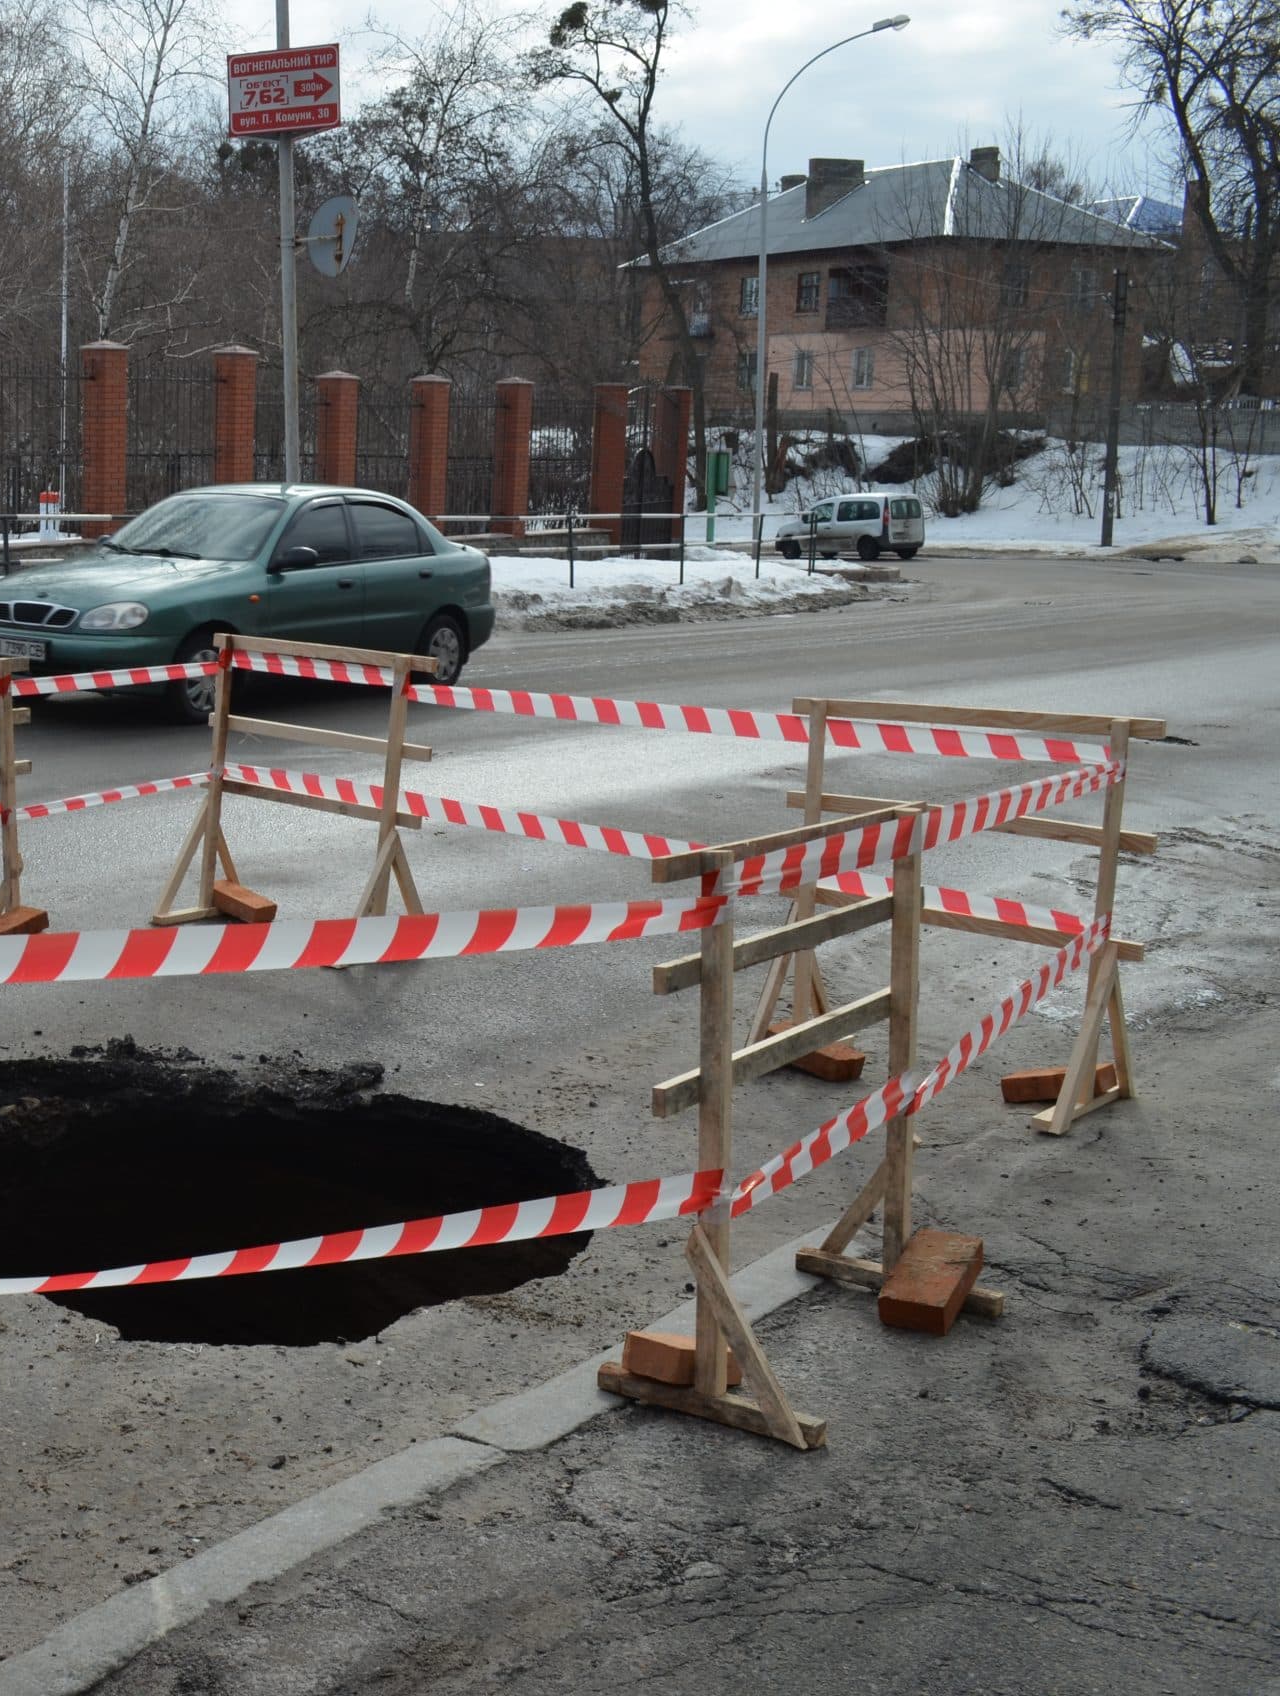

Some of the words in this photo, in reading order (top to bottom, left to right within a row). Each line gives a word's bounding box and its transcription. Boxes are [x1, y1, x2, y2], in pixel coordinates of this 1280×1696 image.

[233, 54, 311, 74] ВОГНЕПАЛЬНИЙ
[314, 53, 333, 65] ТИР
[243, 87, 286, 107] 7,62
[300, 82, 324, 93] 300м
[240, 117, 259, 128] вул.
[262, 113, 273, 124] П.
[275, 110, 315, 123] Комуни,
[318, 108, 330, 119] 30
